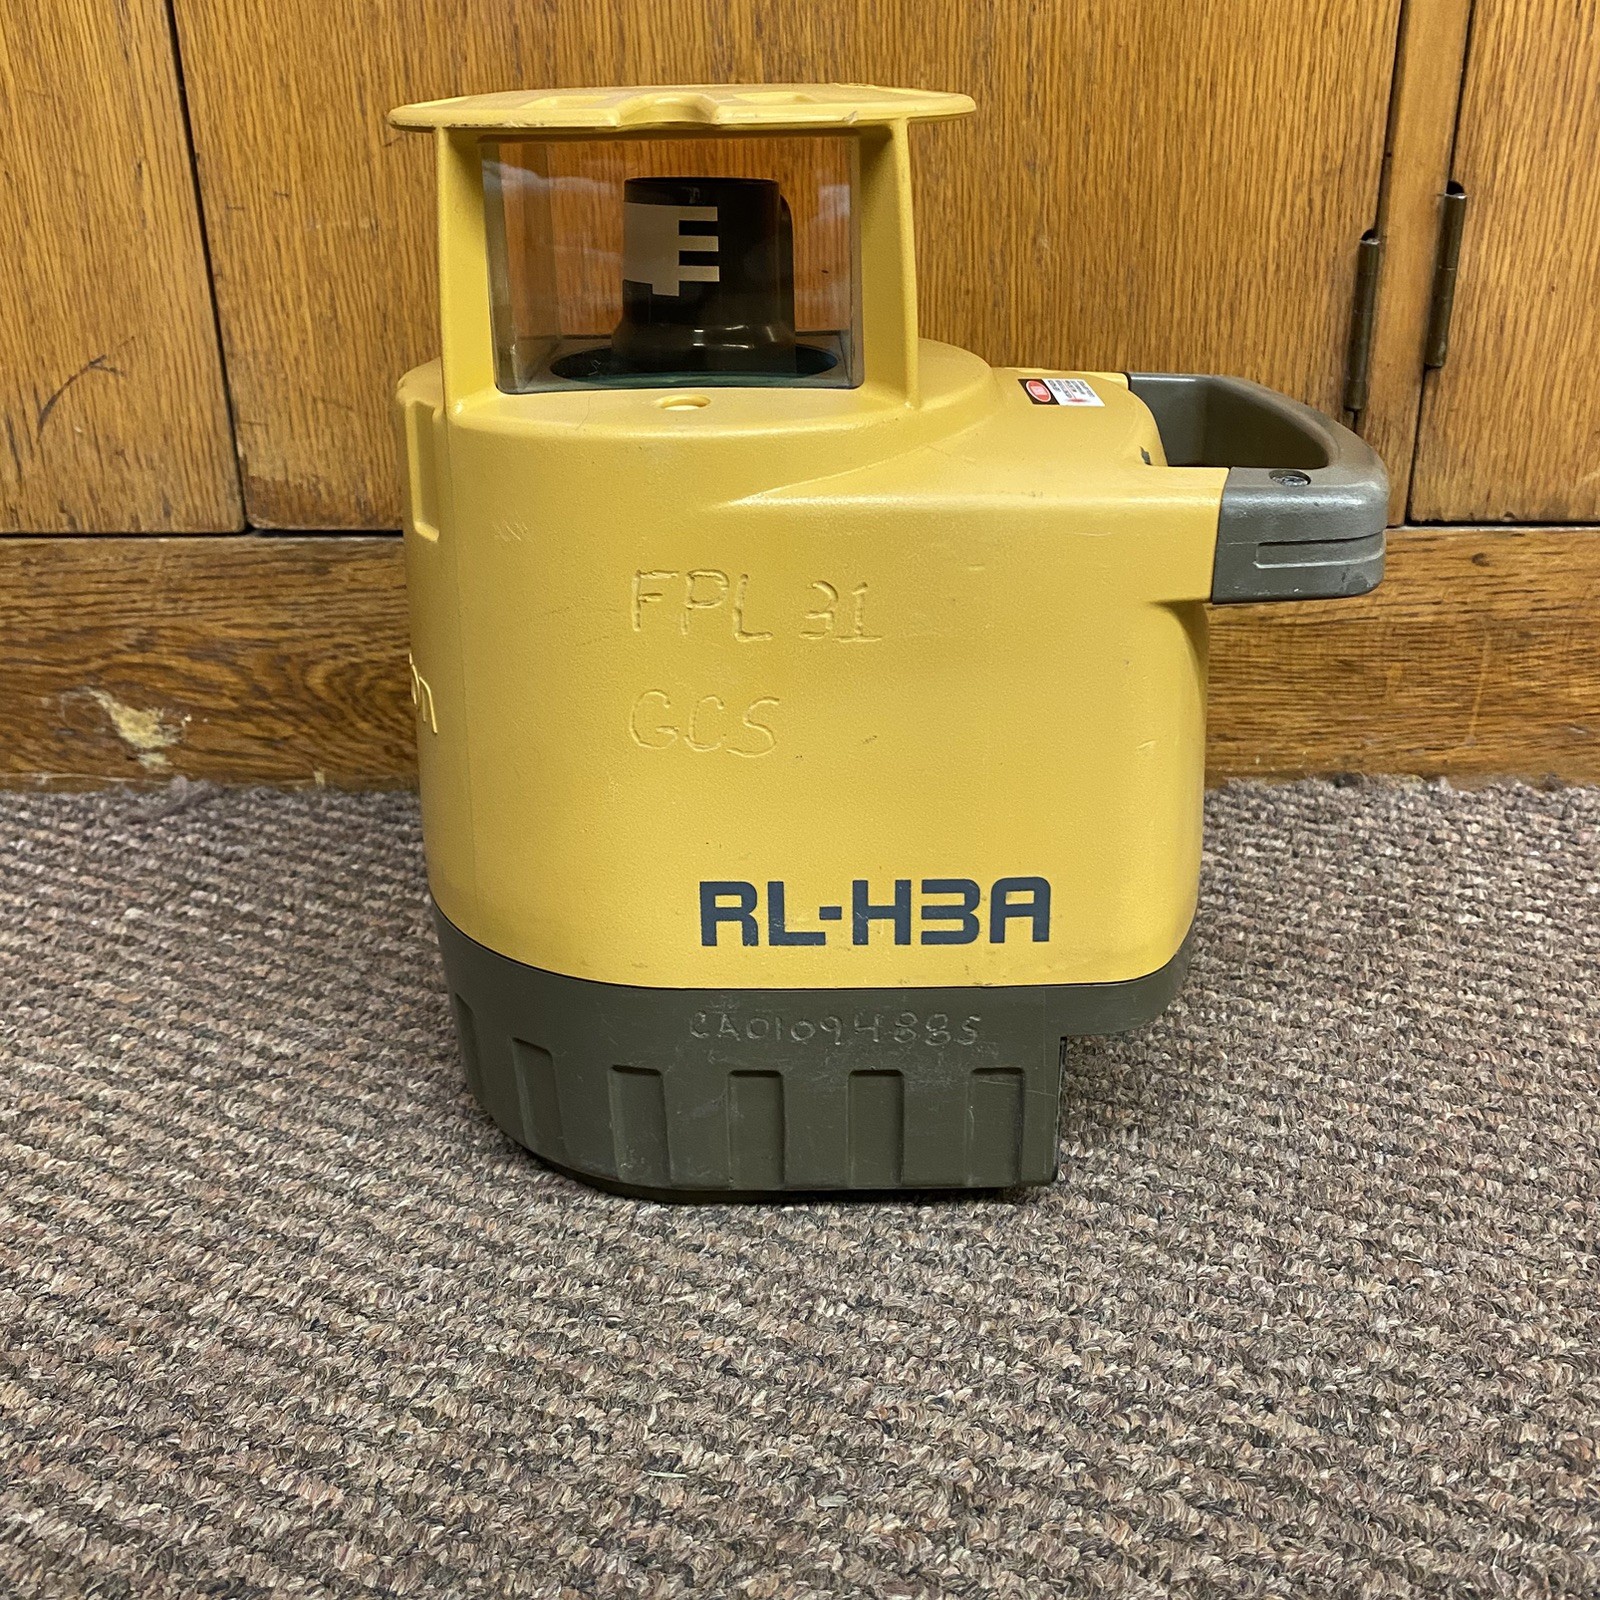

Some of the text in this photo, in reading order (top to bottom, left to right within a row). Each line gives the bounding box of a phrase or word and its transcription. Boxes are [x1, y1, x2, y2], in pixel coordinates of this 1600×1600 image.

[631, 569, 883, 642] FPL 31
[629, 688, 780, 757] GCS
[699, 876, 1051, 947] RL-H3A
